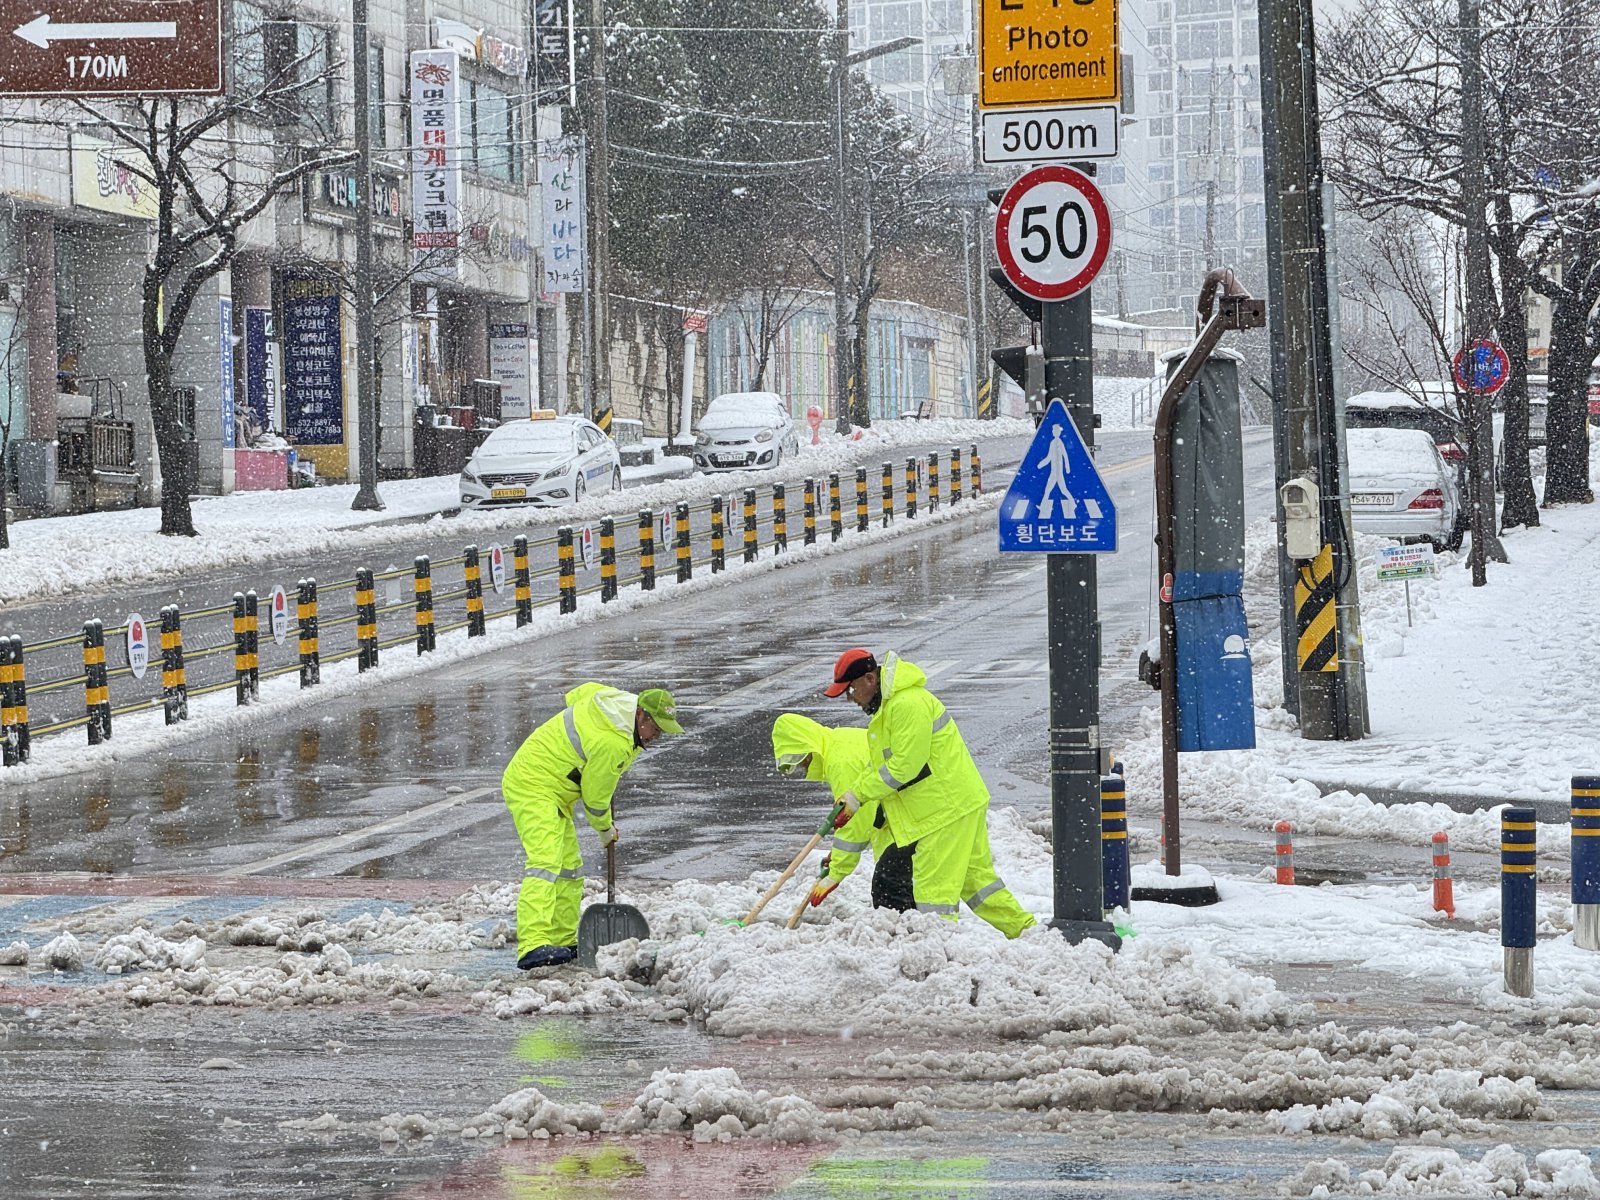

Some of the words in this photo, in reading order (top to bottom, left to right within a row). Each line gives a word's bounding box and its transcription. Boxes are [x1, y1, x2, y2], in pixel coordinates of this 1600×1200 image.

[1008, 25, 1089, 51] Photo
[65, 55, 128, 79] 170M
[992, 56, 1106, 82] enforcement
[1002, 118, 1097, 152] 500m
[551, 173, 578, 261] 산과바다
[1020, 201, 1088, 264] 50
[1015, 523, 1099, 544] 횡단보도
